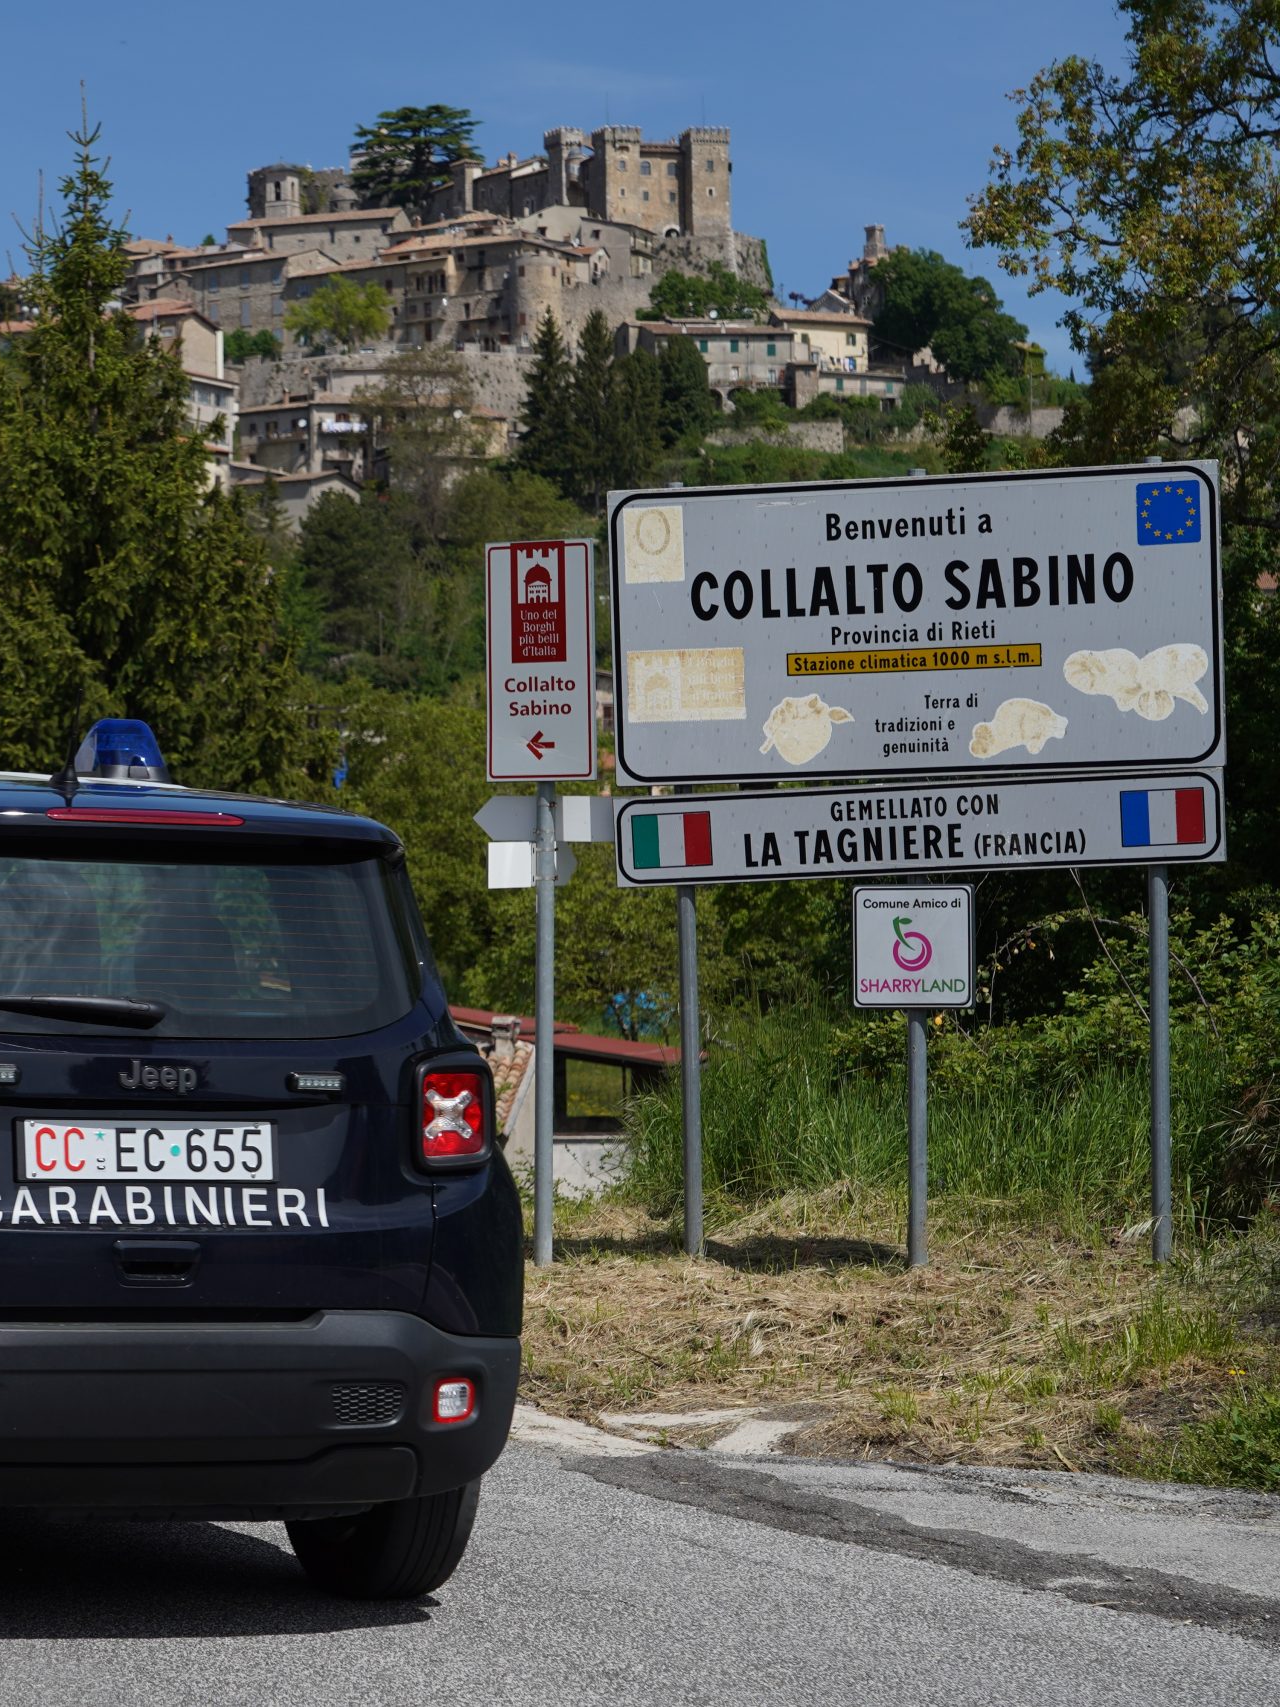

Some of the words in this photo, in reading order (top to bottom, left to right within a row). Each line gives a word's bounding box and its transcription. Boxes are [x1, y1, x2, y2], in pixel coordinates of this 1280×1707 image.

[825, 507, 966, 542] Benvenuti
[977, 511, 993, 534] a
[690, 562, 923, 621] COLLALTO
[944, 551, 1134, 611] SABINO
[520, 610, 540, 621] Uno
[523, 622, 555, 634] Borghi
[831, 623, 919, 646] Provincia
[926, 621, 944, 642] di
[952, 620, 996, 640] Rieti
[519, 634, 535, 646] più
[538, 633, 559, 644] belli
[522, 645, 557, 657] d'Italia
[794, 656, 855, 672] Stazione
[860, 653, 927, 669] climatica
[932, 650, 970, 667] 1000
[976, 653, 988, 665] m
[993, 648, 1035, 664] s.l.m.
[504, 676, 576, 693] Collalto
[509, 700, 572, 717] Sabino
[924, 695, 960, 710] Terra
[966, 693, 979, 708] di
[875, 718, 942, 733] tradizioni
[947, 721, 956, 731] e
[883, 738, 950, 758] genuinità
[830, 796, 948, 822] GEMELLATO
[956, 793, 1000, 816] CON
[743, 832, 782, 868] LA
[793, 823, 964, 866] TAGNIERE
[973, 828, 1087, 860] (FRANCIA)
[863, 899, 910, 909] Comune
[912, 898, 948, 909] Amico
[950, 898, 961, 909] di
[860, 978, 966, 993] SHARRYLAND
[119, 1058, 197, 1094] Jeep
[34, 1127, 86, 1172] CC
[116, 1127, 165, 1173] EC
[186, 1128, 263, 1173] 655
